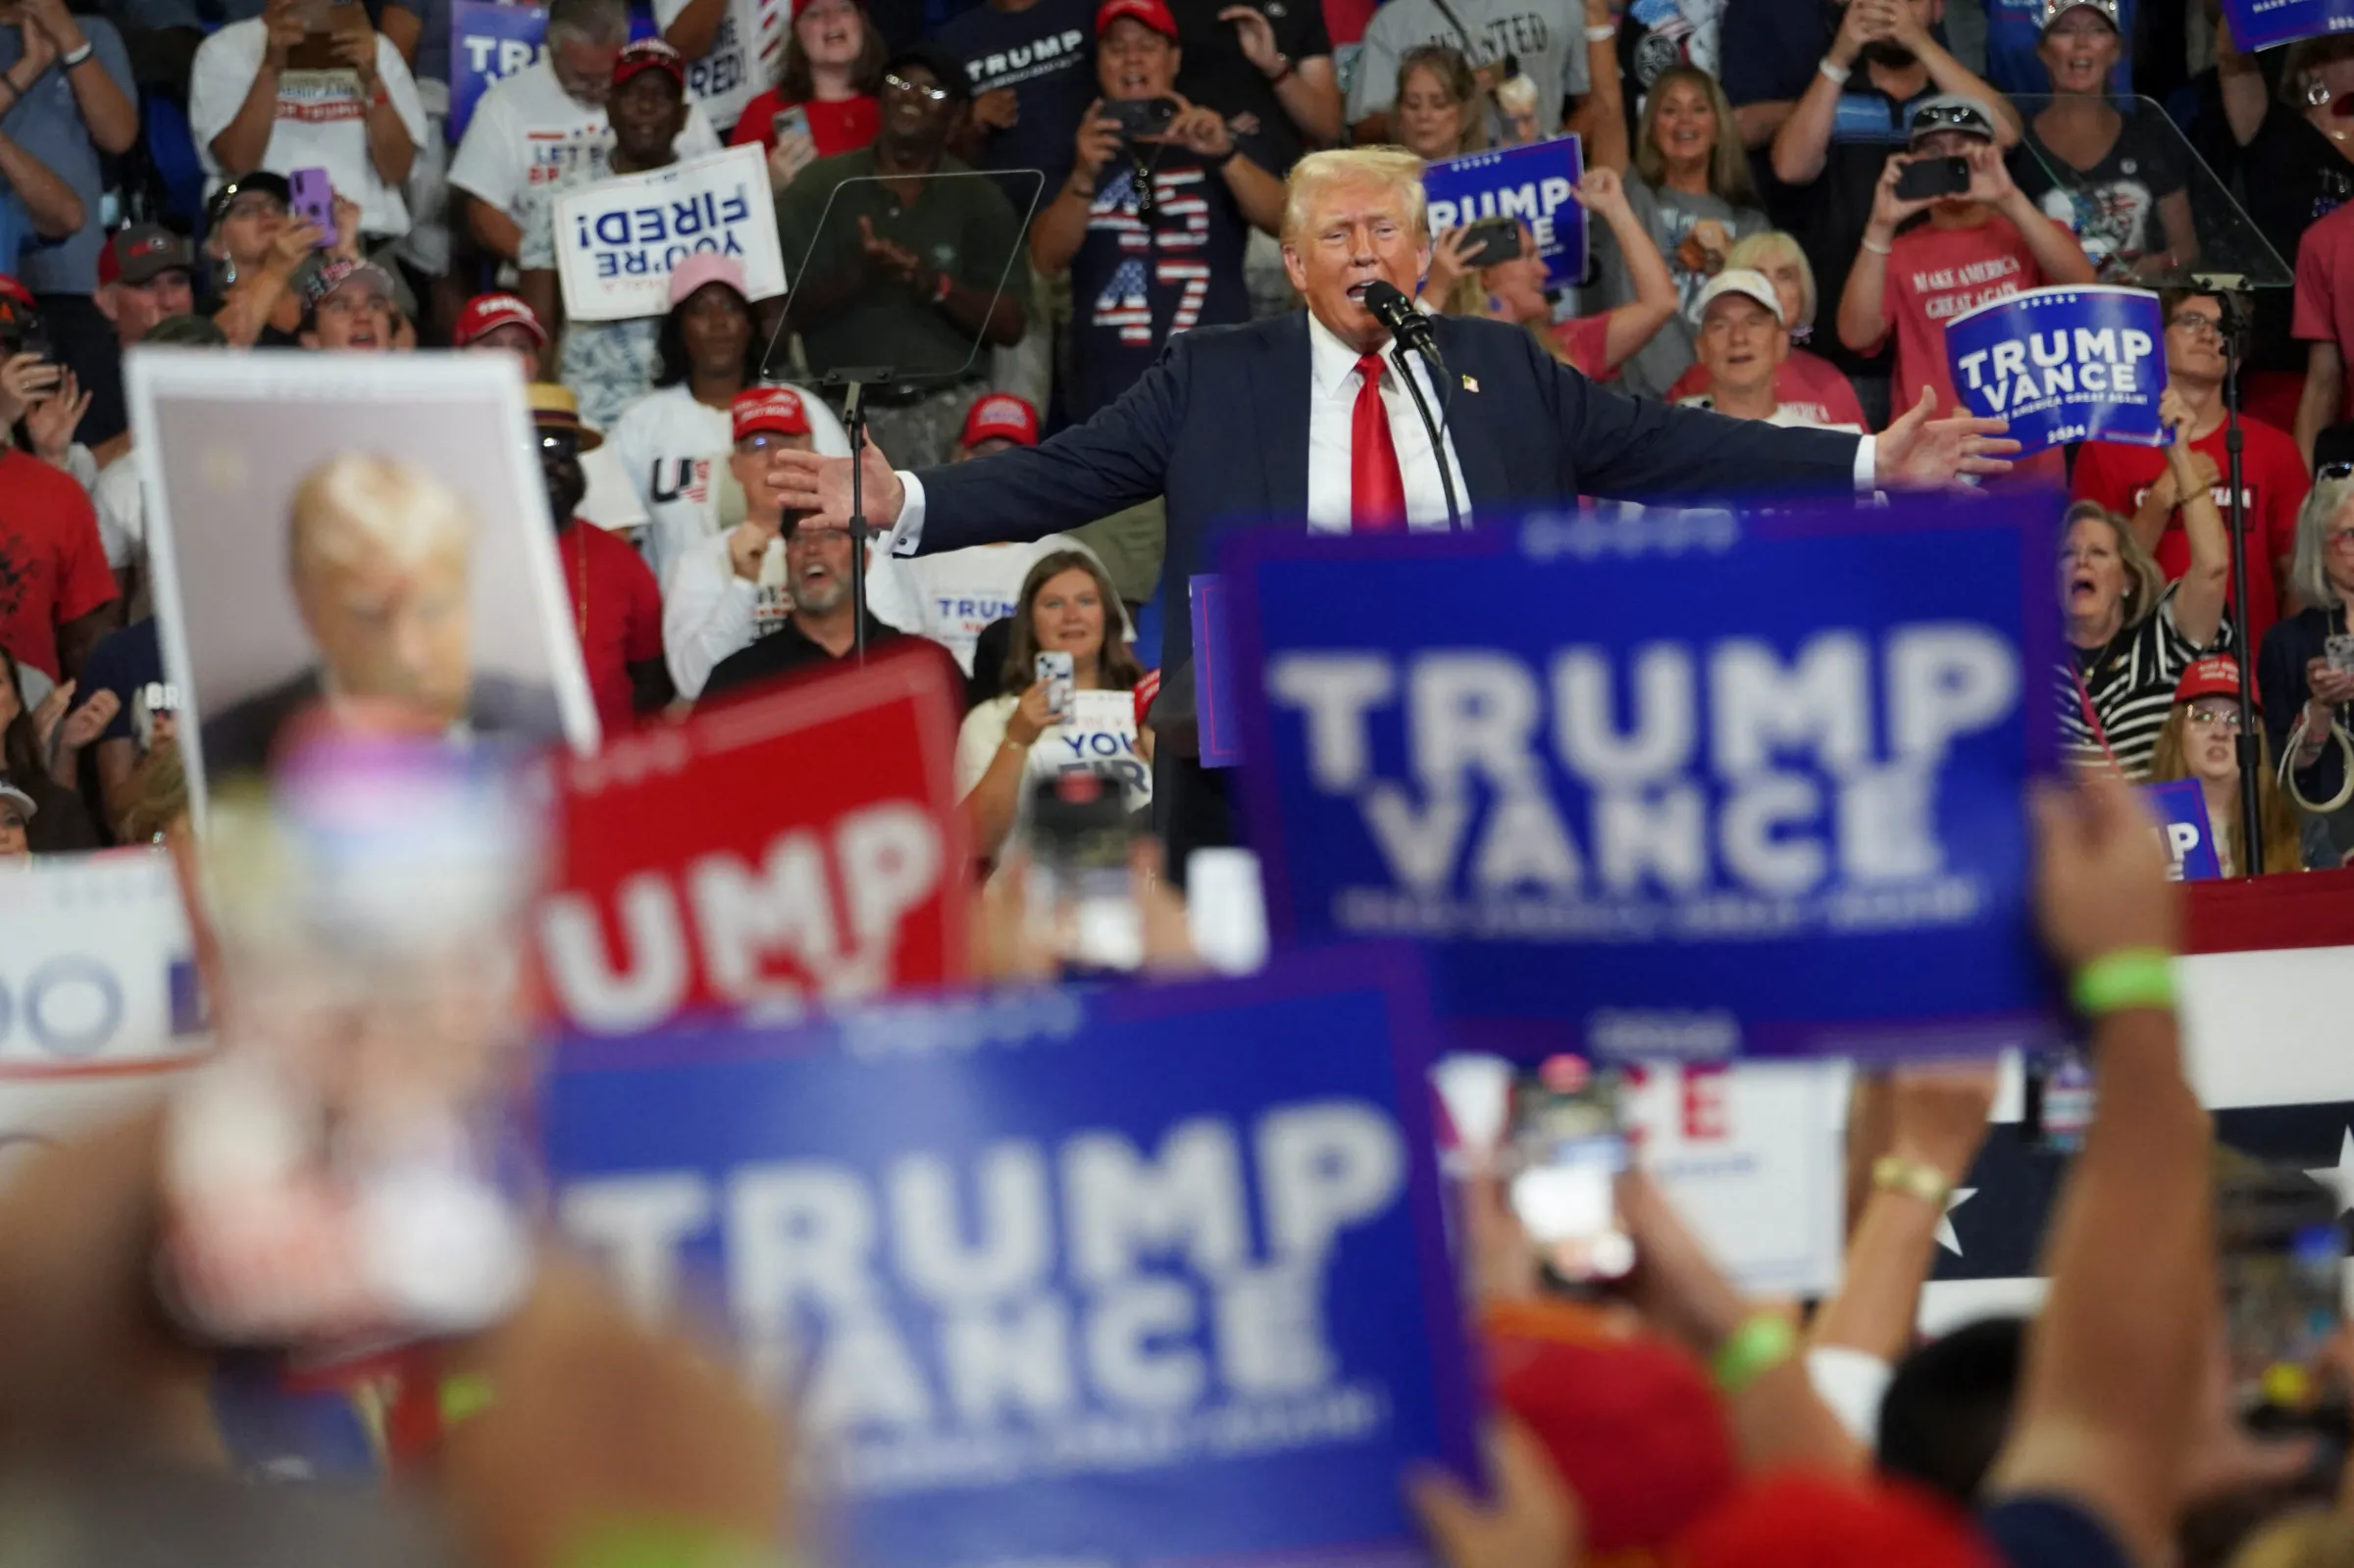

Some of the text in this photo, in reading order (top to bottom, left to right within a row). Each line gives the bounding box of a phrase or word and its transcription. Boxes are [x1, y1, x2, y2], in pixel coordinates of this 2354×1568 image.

[965, 28, 1083, 82] TRUMP
[576, 181, 751, 249] FIRED!
[1089, 167, 1209, 253] 45
[1092, 258, 1210, 348] 47
[1959, 327, 2154, 390] TRUMP
[1980, 362, 2138, 413] VANCE
[2046, 424, 2086, 444] 2024
[1265, 622, 2023, 792] TRUMP
[1361, 768, 1948, 895] VANCE
[558, 1098, 1406, 1339] TRUMP
[785, 1263, 1342, 1437] ANCE
